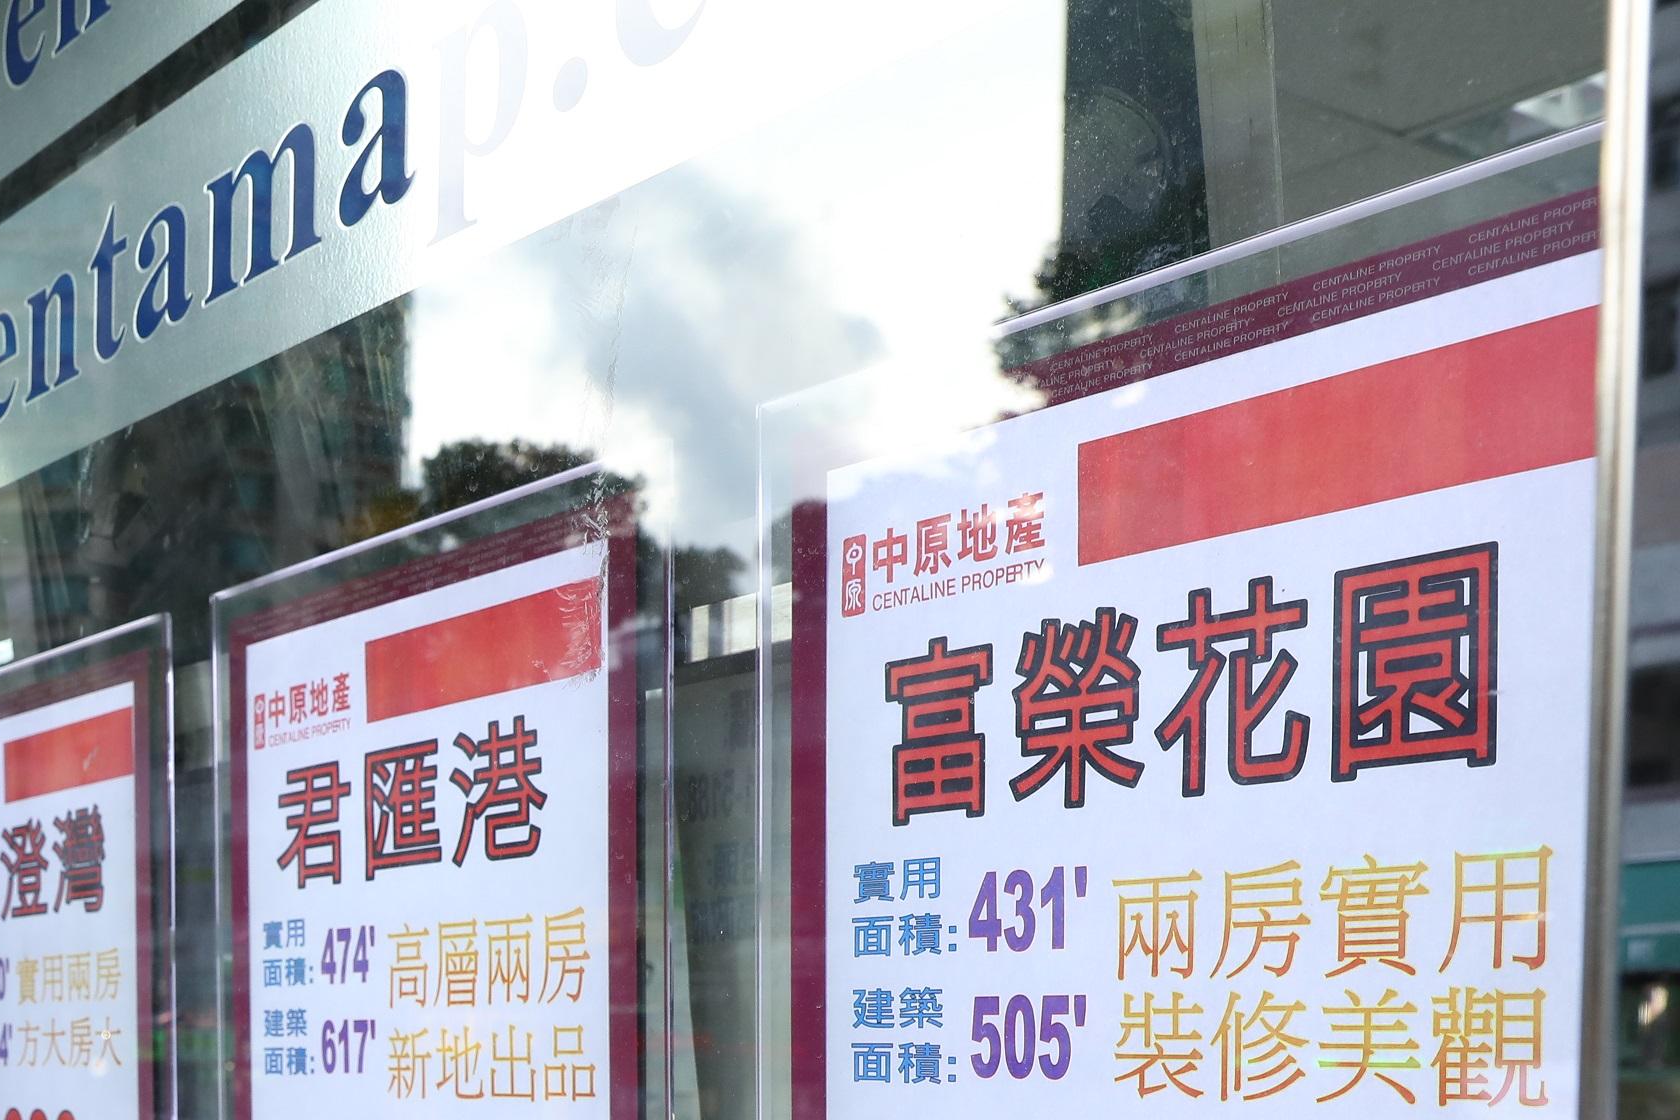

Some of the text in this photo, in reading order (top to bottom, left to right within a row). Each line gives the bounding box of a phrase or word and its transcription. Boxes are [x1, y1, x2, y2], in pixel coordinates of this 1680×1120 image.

[1174, 198, 1596, 334] CENTALINE PROPERTY CENTALINE PROPERTY CENTALINE PROPER
[1174, 229, 1596, 363] CENTALINE PROPERTY CENTALINE PROPERTY CENTALINE PROPER
[1277, 220, 1575, 317] CENTALINE PROPERTY CENTALINE PROPERTY
[872, 492, 1047, 585] 中原地產
[872, 557, 1046, 612] CENTALINE PROPERTY
[269, 672, 350, 729] 中原地產
[885, 541, 1499, 827] 富榮花園
[277, 715, 548, 890] 君匯港
[263, 906, 592, 1009] 實用 高層兩房
[321, 925, 375, 986] 474'
[853, 865, 1088, 957] 面積: 431'
[853, 843, 1555, 982] 實用 兩房實用
[263, 1007, 596, 1102] 建築 新地出品
[321, 1019, 376, 1076] 617'
[853, 994, 1088, 1085] 面積: 505'
[853, 987, 1550, 1110] 建築 裝修美觀
